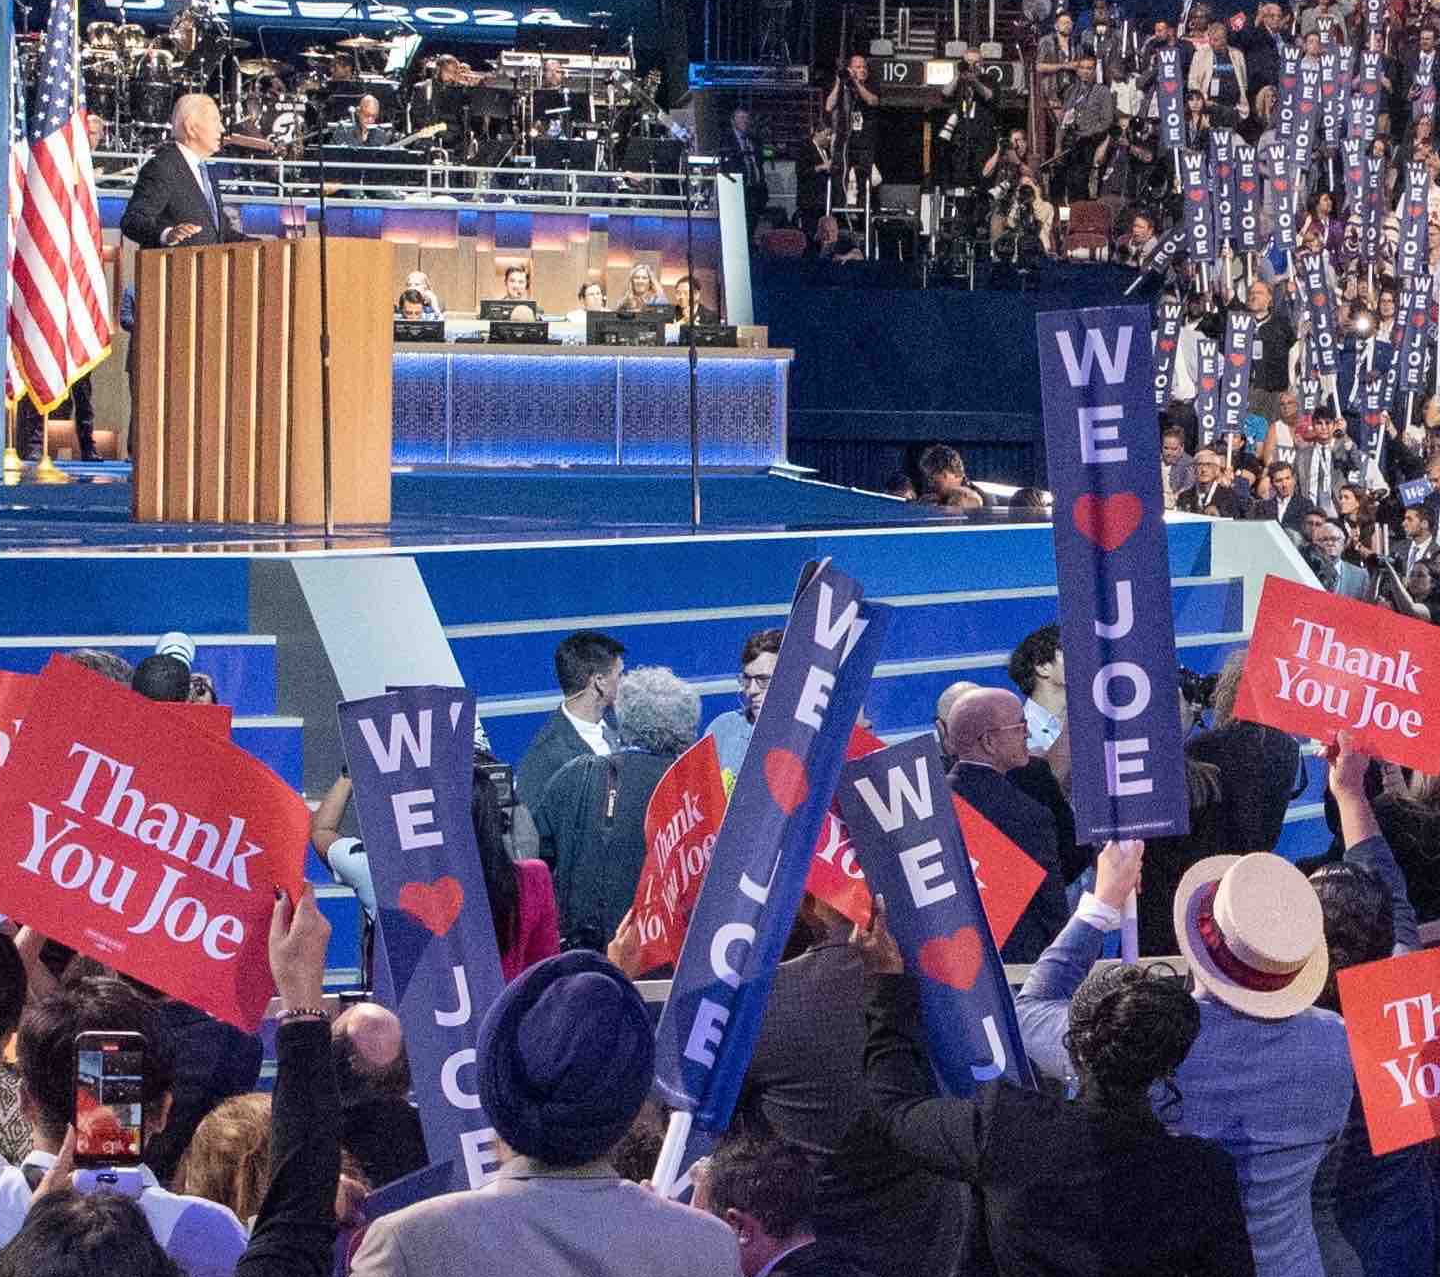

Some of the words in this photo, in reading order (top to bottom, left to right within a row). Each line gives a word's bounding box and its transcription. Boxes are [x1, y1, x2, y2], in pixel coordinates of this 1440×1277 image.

[883, 63, 908, 82] 119
[1184, 155, 1201, 185] WE
[1194, 208, 1208, 254] JOE
[1055, 327, 1133, 465] WE
[1090, 580, 1155, 798] JOE
[1274, 659, 1351, 717] You
[1352, 690, 1423, 740] Joe
[1291, 617, 1423, 696] Thank
[63, 741, 263, 892] Thank
[358, 711, 444, 851] WE
[853, 757, 957, 909] WE
[19, 802, 129, 914] You
[127, 867, 245, 962] Joe
